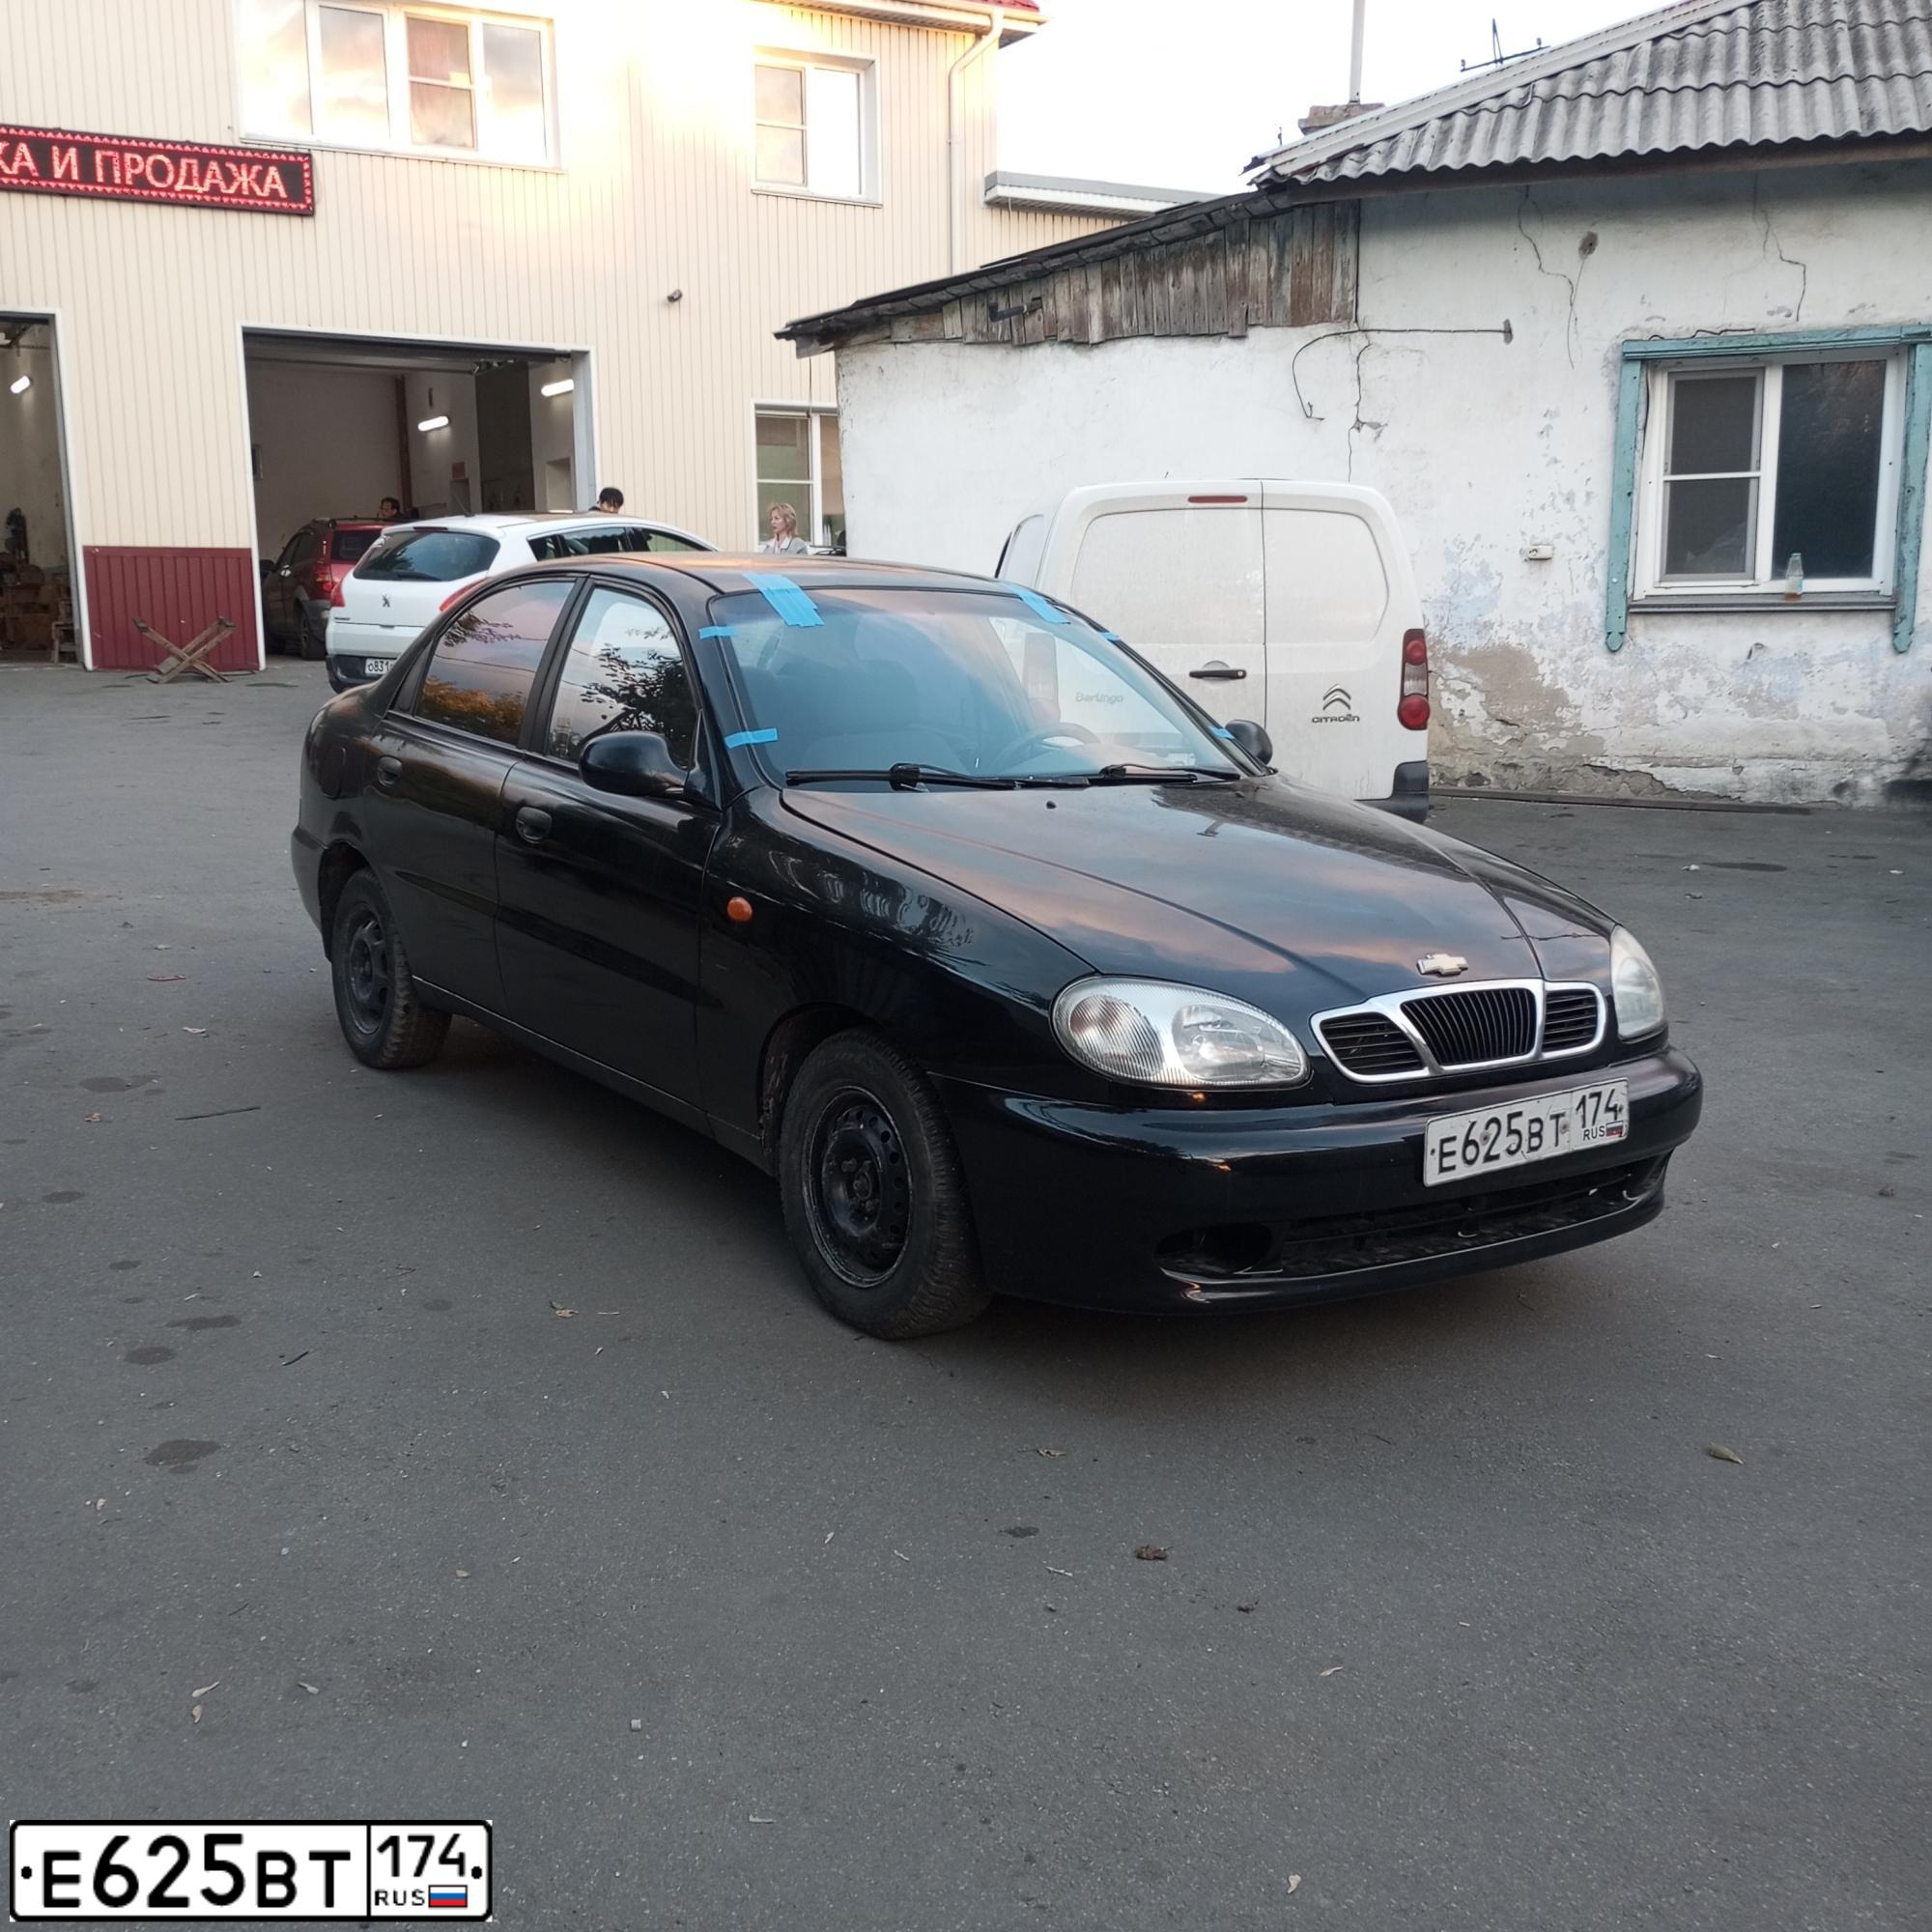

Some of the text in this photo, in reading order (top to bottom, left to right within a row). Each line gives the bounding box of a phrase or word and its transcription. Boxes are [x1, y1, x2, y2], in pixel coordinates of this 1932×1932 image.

[52, 146, 79, 181] И
[95, 150, 288, 198] ПРОДАЖА
[1075, 692, 1124, 705] Berlingo
[1576, 1089, 1619, 1129] 174
[1582, 1126, 1606, 1142] RUS
